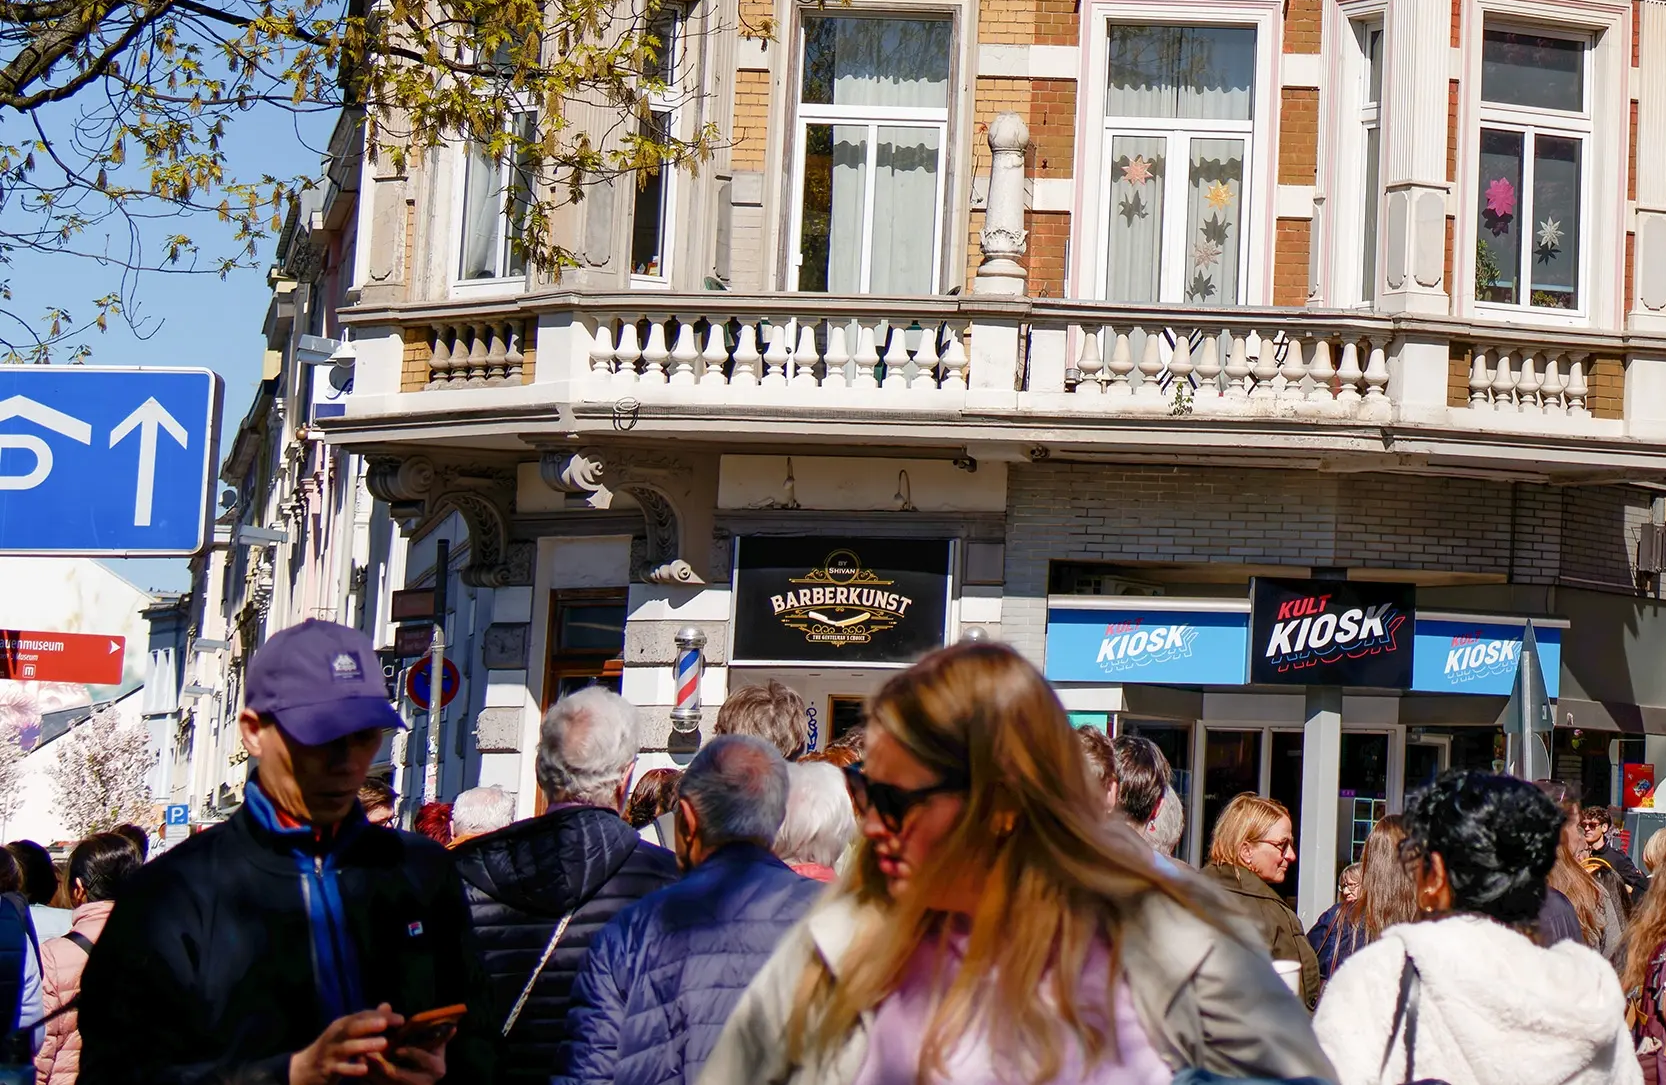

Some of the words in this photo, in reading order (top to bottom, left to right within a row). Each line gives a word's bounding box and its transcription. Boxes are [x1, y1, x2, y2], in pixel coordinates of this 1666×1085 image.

[770, 587, 912, 614] BARBERKUNST
[1277, 594, 1332, 620] KULT
[1105, 617, 1144, 636] KULT
[1266, 603, 1392, 658] KIOSK
[1451, 630, 1484, 647] KULT
[1096, 623, 1189, 663] KIOSK
[1444, 636, 1519, 674] KIOSK
[171, 807, 185, 823] P
